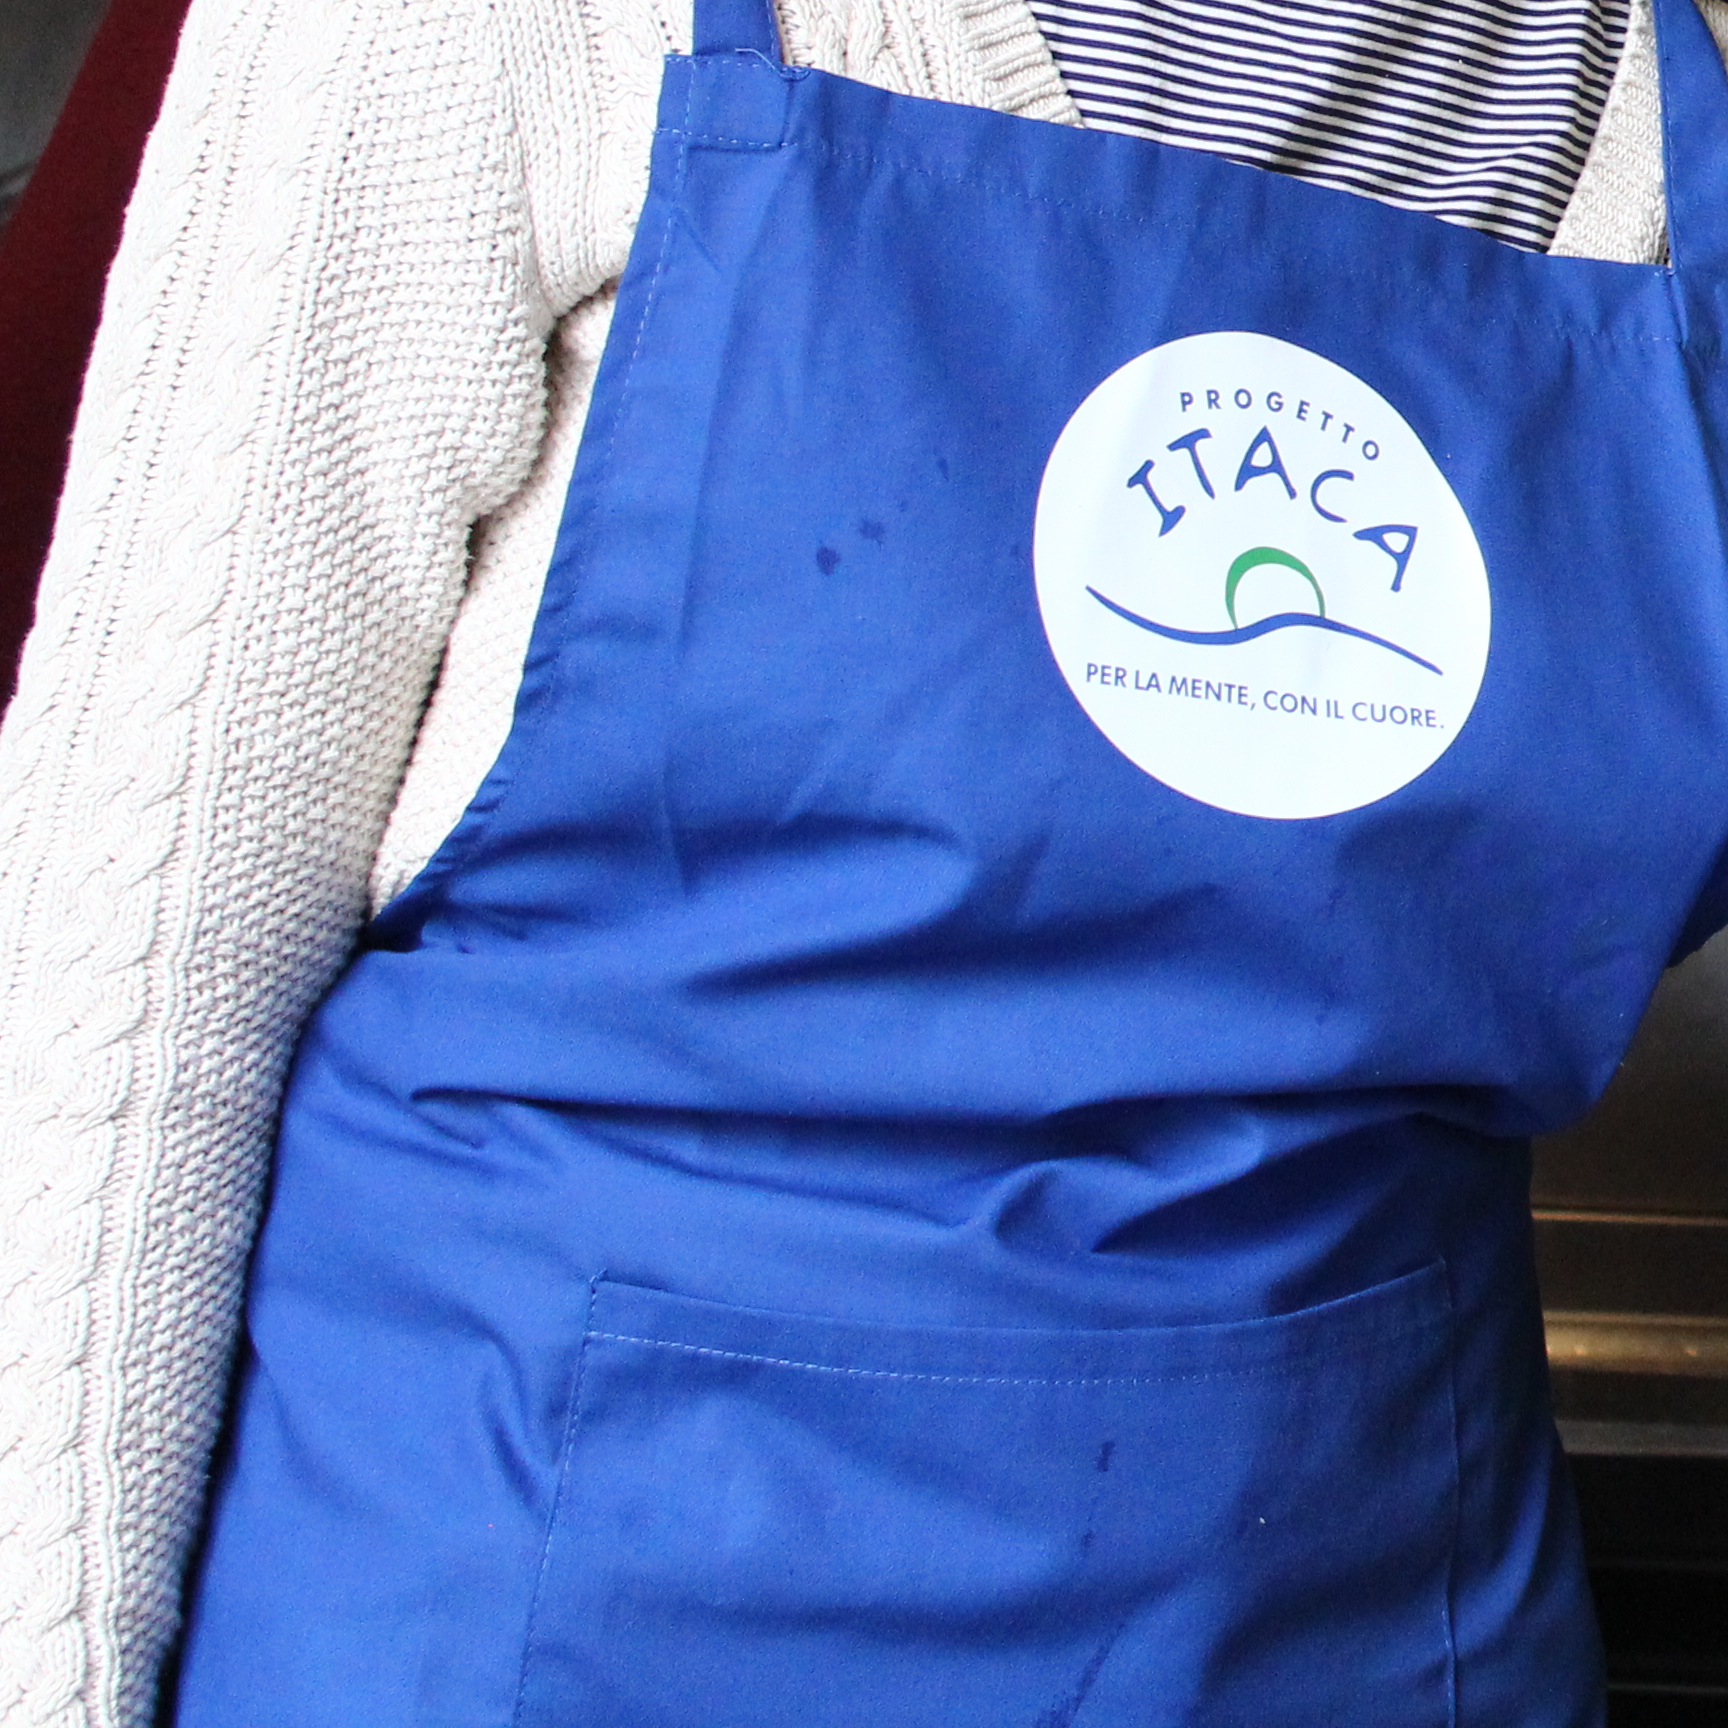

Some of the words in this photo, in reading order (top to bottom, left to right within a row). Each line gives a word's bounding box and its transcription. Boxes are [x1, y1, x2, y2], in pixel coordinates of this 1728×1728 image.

[1179, 388, 1380, 461] PROGETTO
[1126, 424, 1418, 593] ITACA
[1086, 662, 1128, 688] PER
[1134, 669, 1162, 694] LA
[1168, 674, 1257, 711] MENTE,
[1262, 689, 1318, 717] CON
[1325, 699, 1345, 720] IL
[1351, 701, 1445, 730] CUORE.
